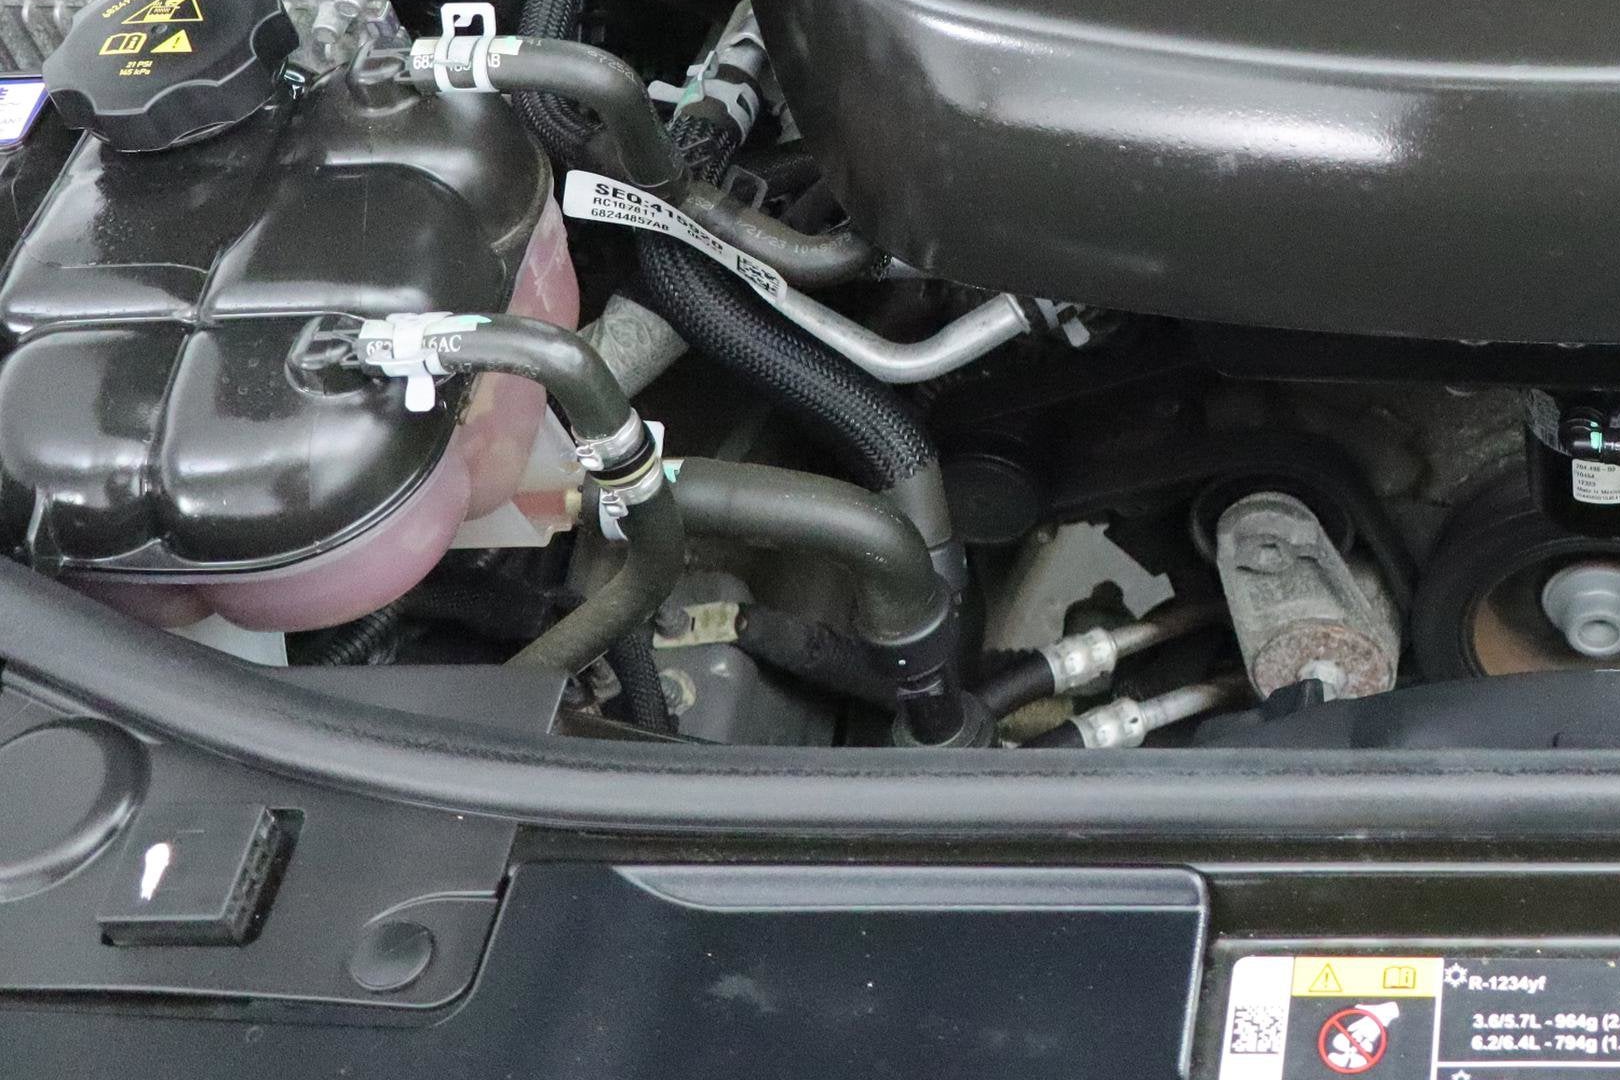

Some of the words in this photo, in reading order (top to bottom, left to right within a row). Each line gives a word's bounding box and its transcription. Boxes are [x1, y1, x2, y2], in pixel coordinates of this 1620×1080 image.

[1468, 975, 1548, 995] R-1234yf
[1472, 1013, 1542, 1030] 3.6/5.7L
[1554, 1013, 1599, 1033] 964g
[1471, 1034, 1542, 1051] 6.2/6.4L
[1554, 1034, 1599, 1054] 794g
